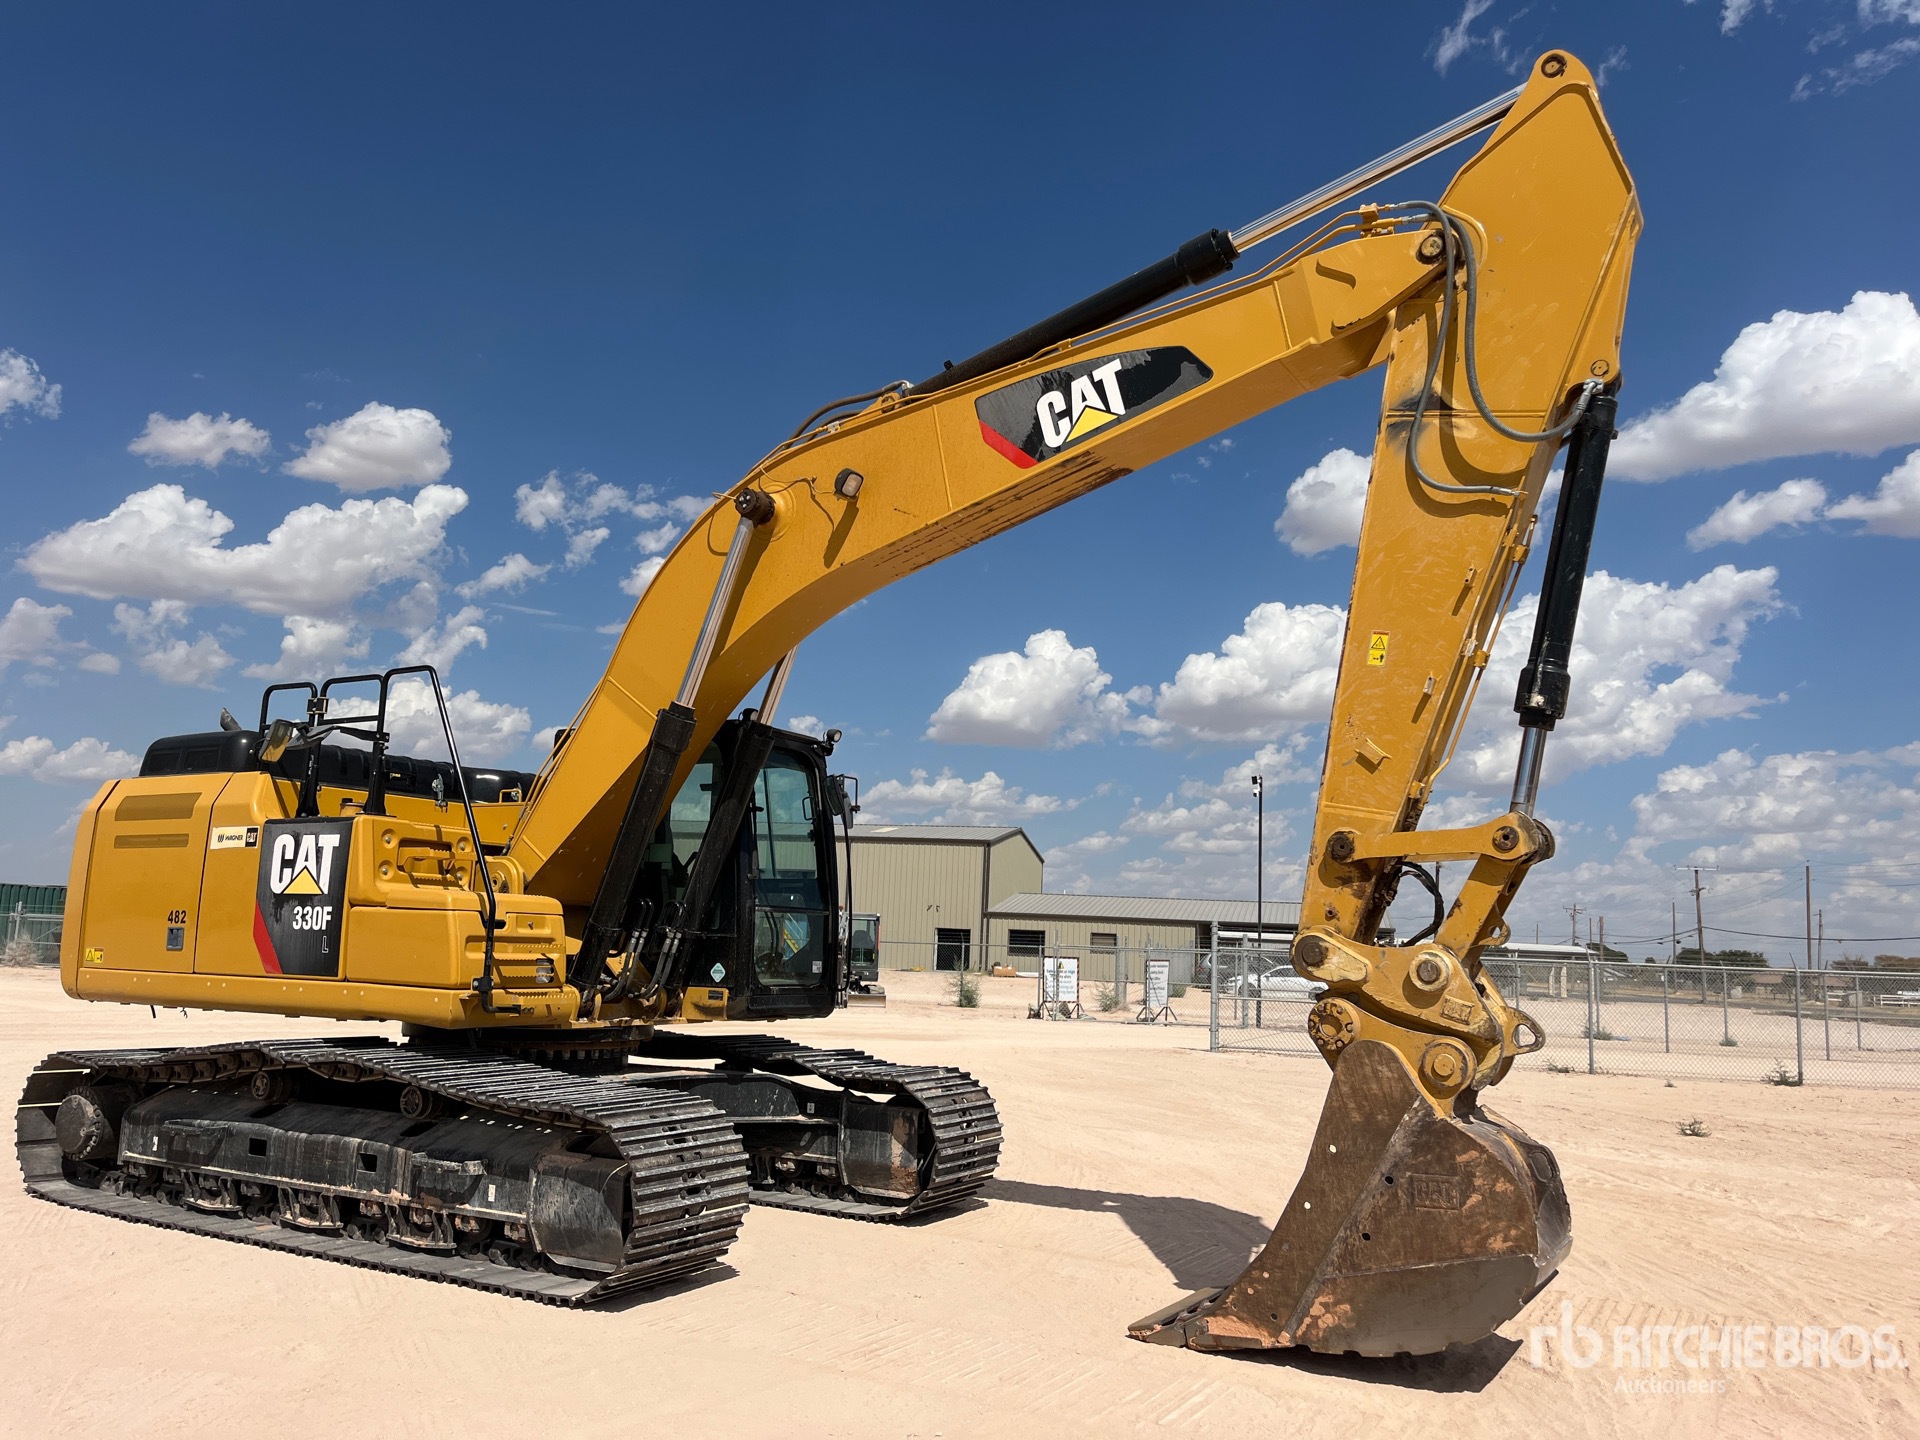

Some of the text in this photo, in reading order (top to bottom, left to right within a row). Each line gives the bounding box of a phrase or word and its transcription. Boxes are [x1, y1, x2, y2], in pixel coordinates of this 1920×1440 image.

[1036, 358, 1126, 448] CAT
[270, 834, 341, 894] CAT
[167, 910, 187, 924] 482
[293, 906, 333, 931] 330F
[321, 935, 329, 953] L
